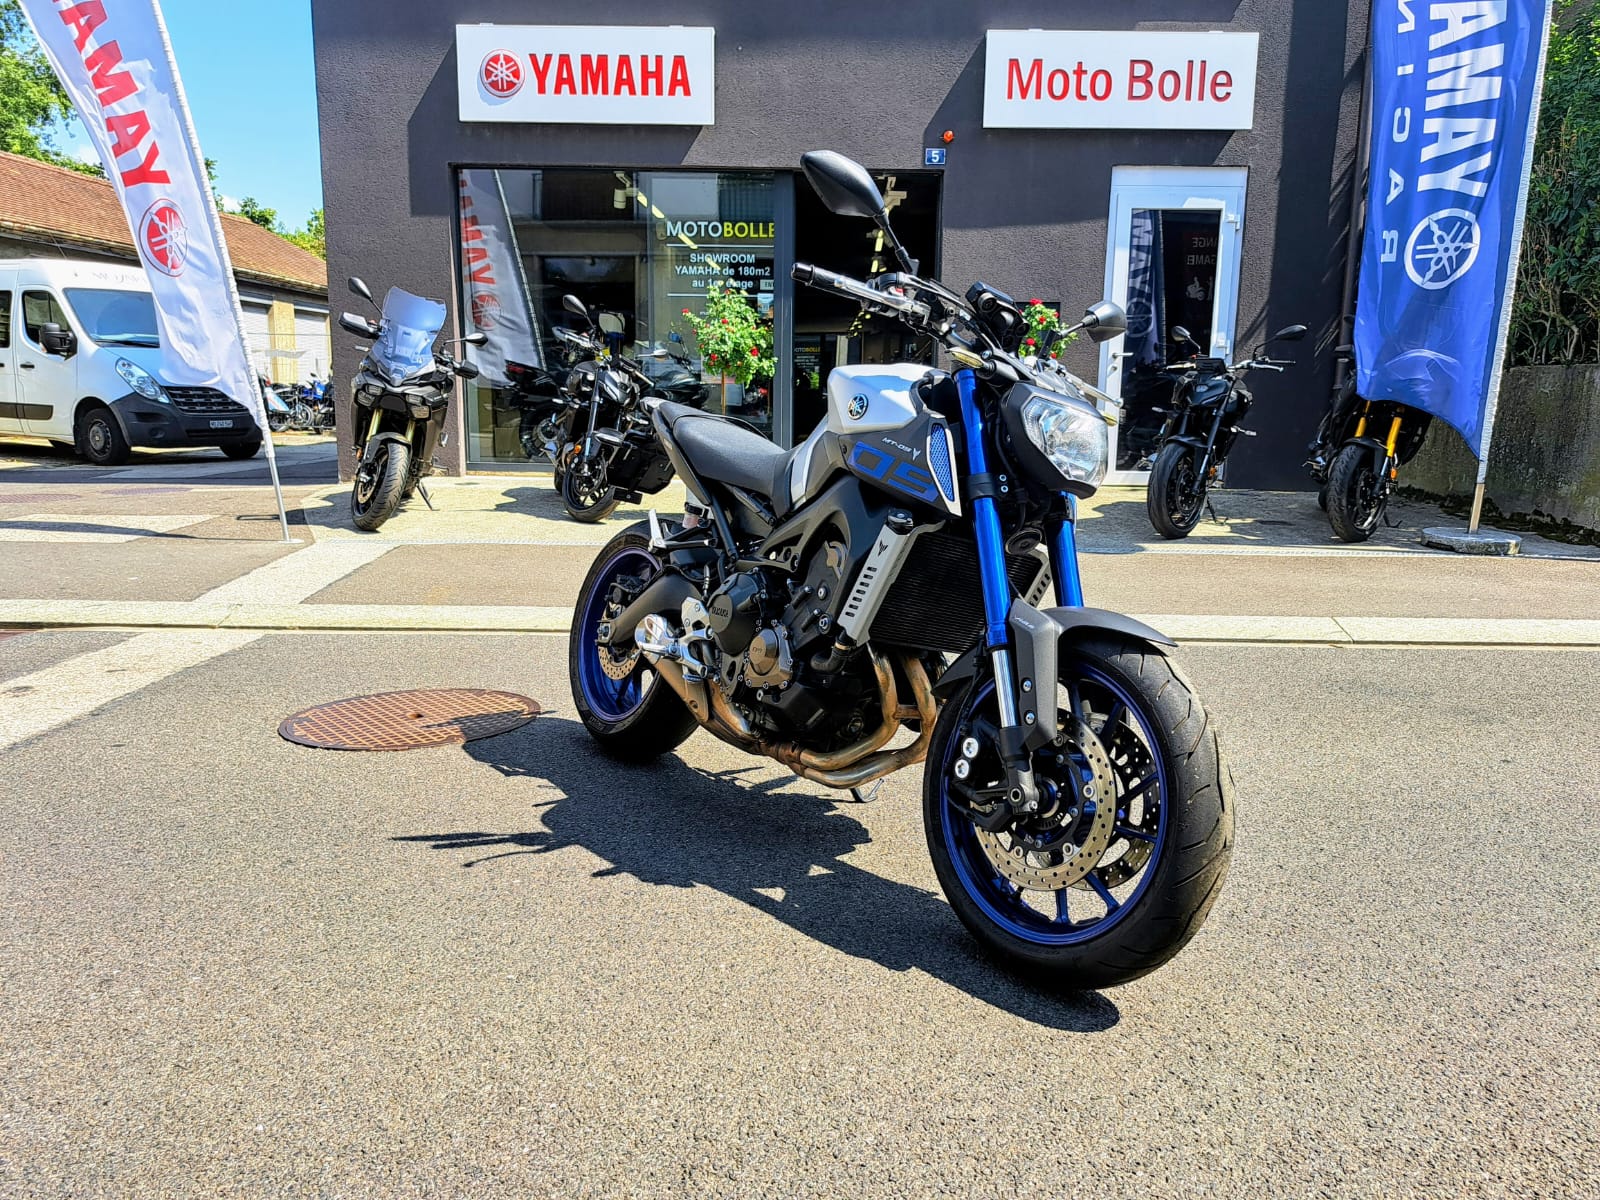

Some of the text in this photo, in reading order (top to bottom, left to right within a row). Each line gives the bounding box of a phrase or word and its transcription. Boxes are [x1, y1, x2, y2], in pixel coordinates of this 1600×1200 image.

[529, 54, 691, 97] YAMAHA
[1006, 58, 1233, 102] Moto Bolle
[931, 150, 940, 163] 5
[666, 221, 775, 238] MOTOBOLLE
[690, 253, 756, 264] SHOWROOM
[674, 266, 771, 276] YAMAHA de 180m2
[692, 280, 705, 288] au
[725, 278, 754, 290] éage
